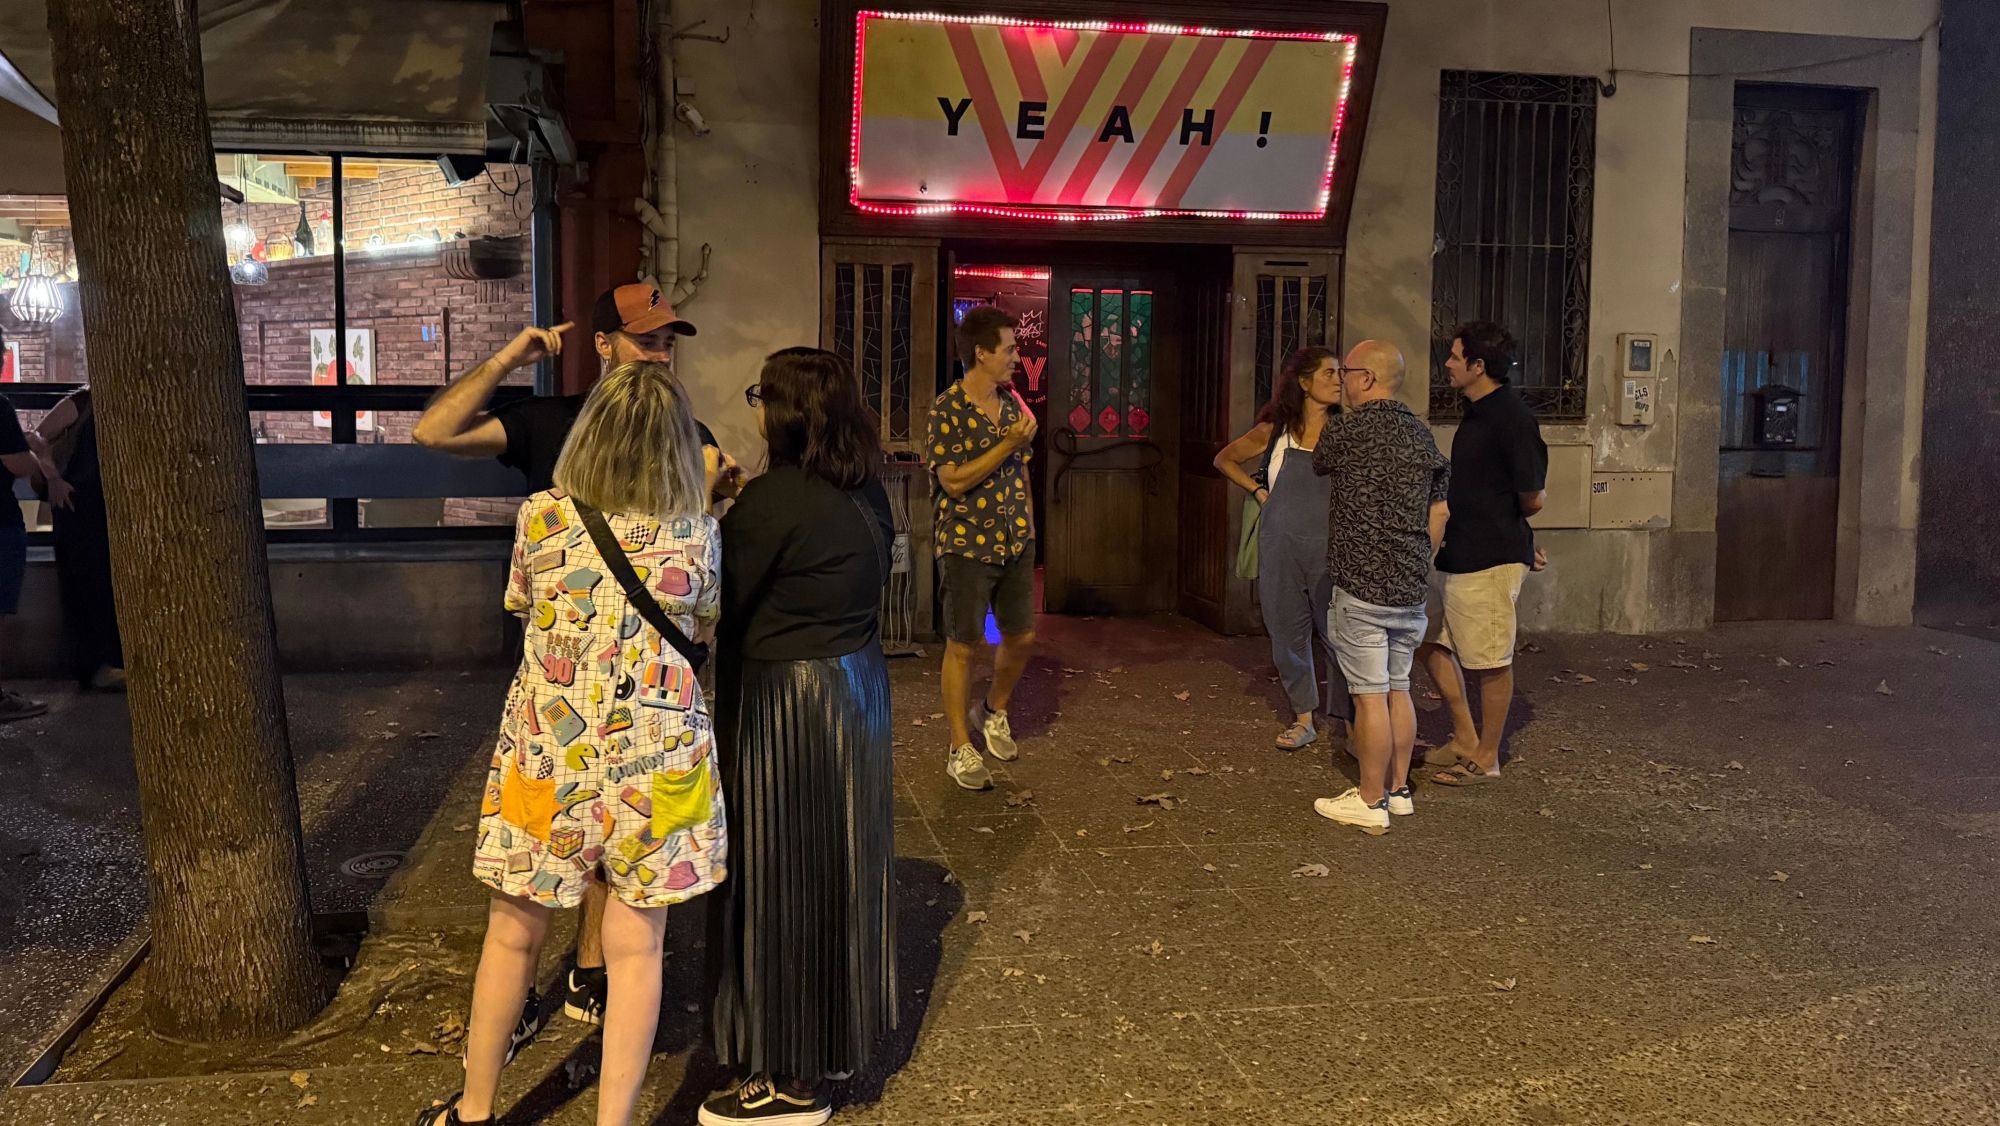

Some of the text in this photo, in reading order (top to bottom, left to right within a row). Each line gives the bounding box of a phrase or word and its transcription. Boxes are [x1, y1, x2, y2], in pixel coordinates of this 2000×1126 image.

[937, 97, 1272, 149] YEAH!
[1021, 356, 1047, 391] Y
[543, 654, 574, 686] 90
